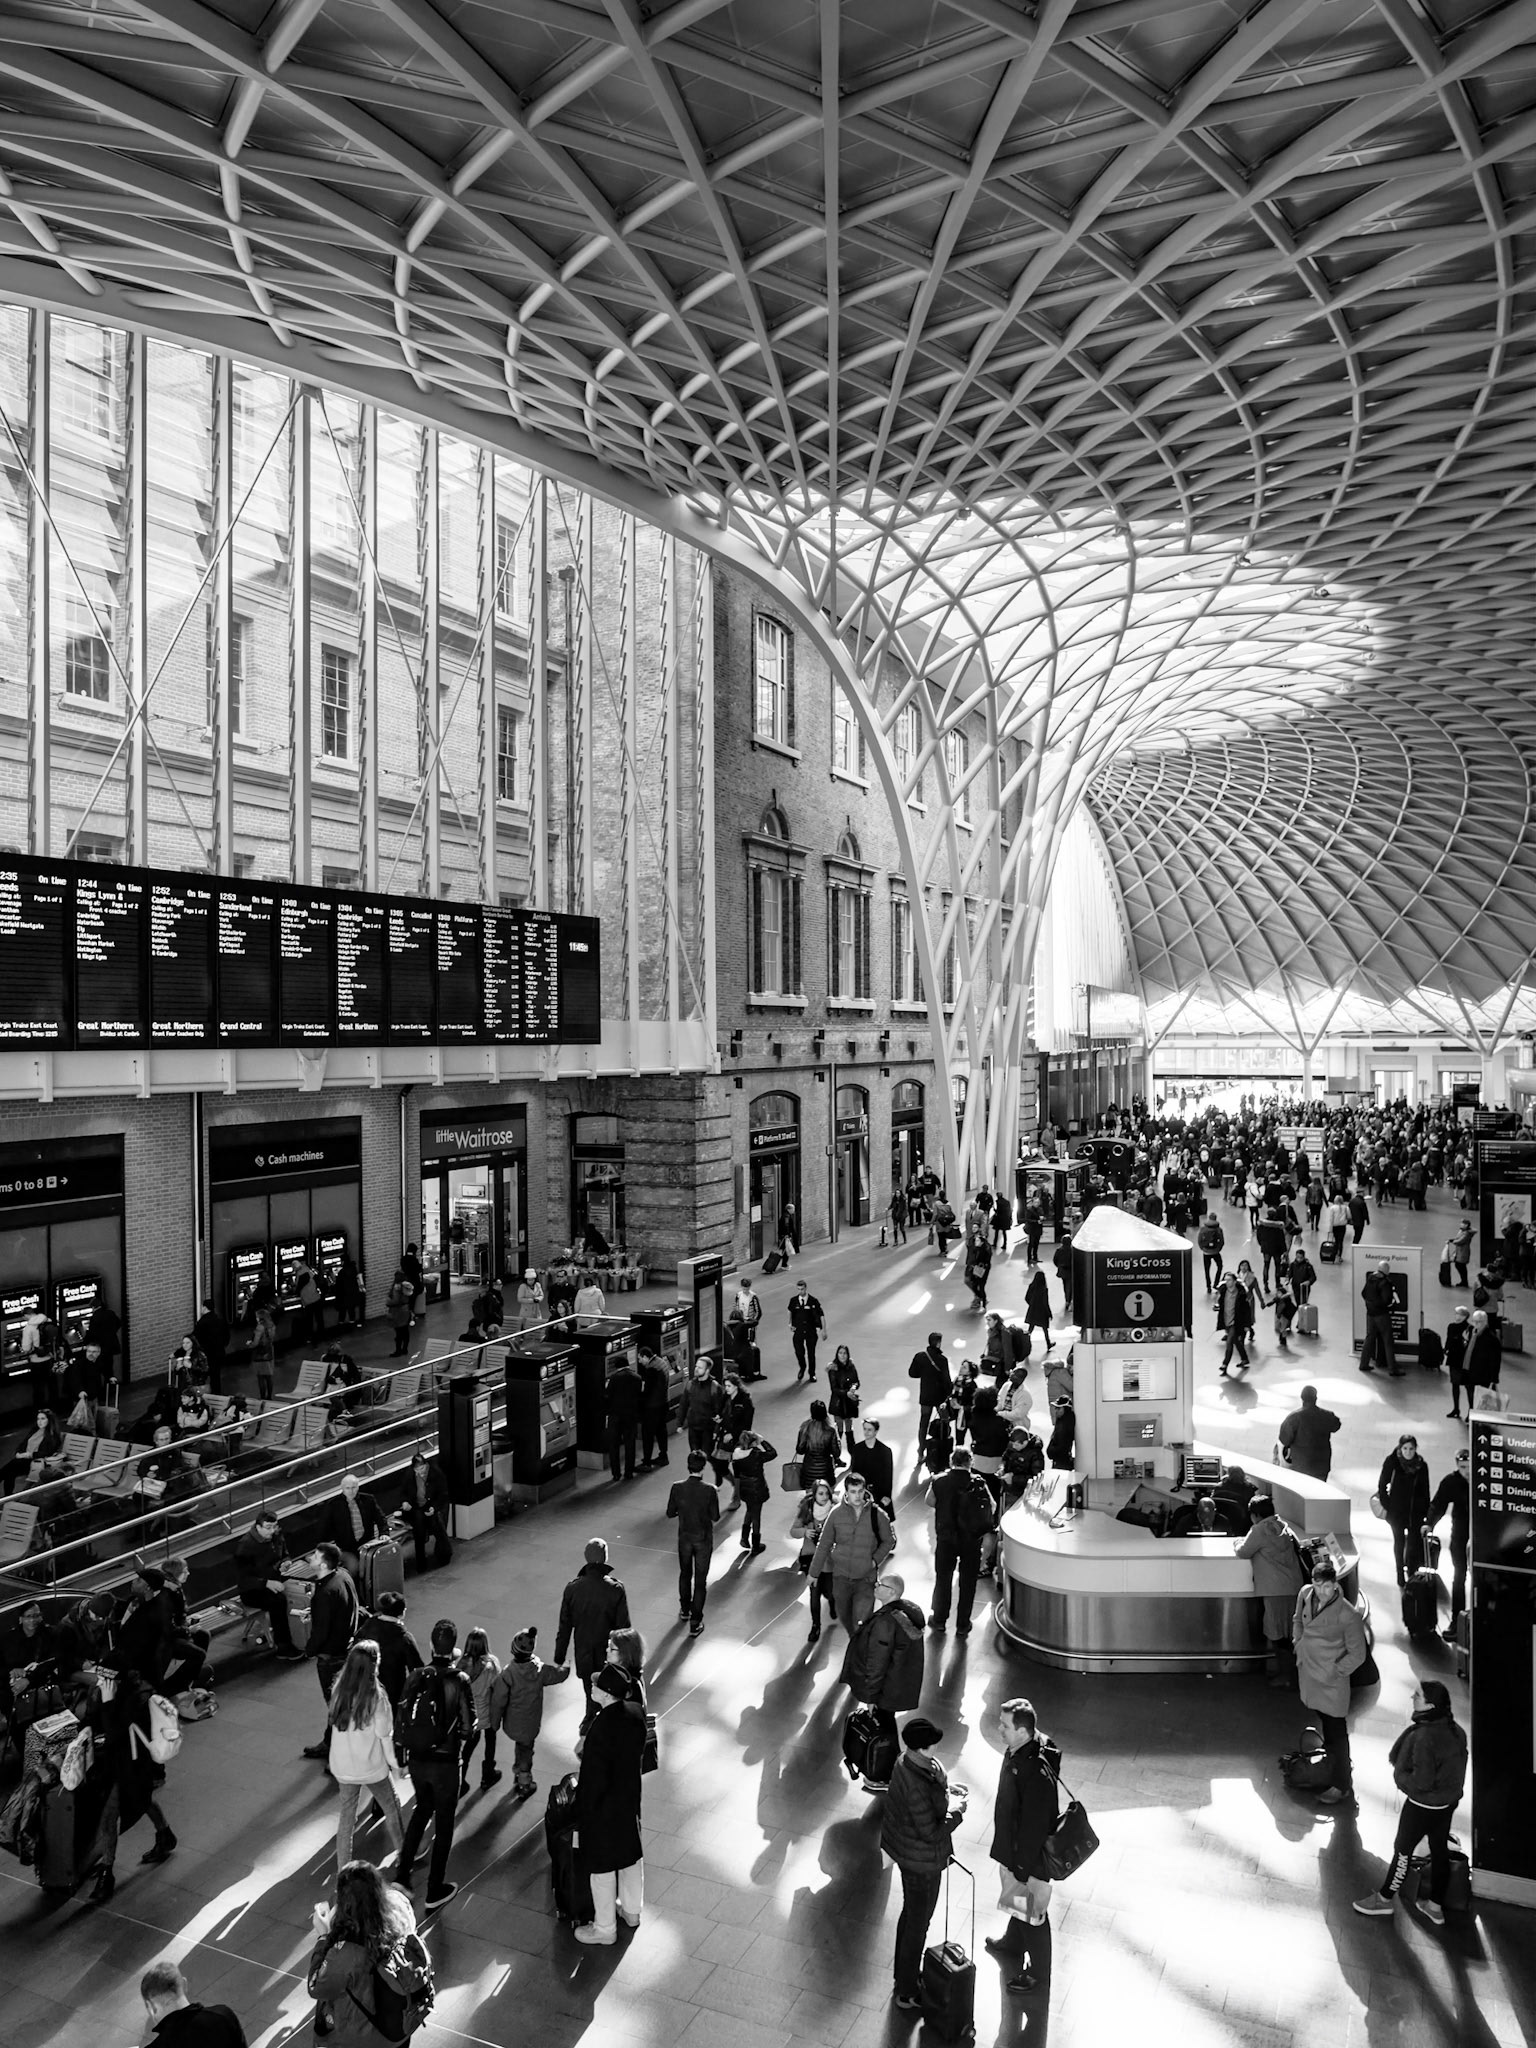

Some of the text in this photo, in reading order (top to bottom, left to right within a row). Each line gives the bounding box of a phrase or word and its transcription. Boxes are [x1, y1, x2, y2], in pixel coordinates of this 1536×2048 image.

[38, 875, 48, 884] On
[51, 876, 66, 885] time
[78, 879, 142, 892] 12:44 On time
[0, 883, 18, 891] eeds
[153, 886, 170, 895] 12:52
[198, 891, 211, 899] time
[77, 889, 96, 899] Kings
[98, 891, 116, 900] Lynn
[152, 896, 184, 906] Cambridge
[220, 893, 236, 901] 12:53
[219, 902, 252, 911] Sunderland
[436, 1127, 513, 1149] little Waitrose
[268, 1151, 324, 1165] Cash machines
[15, 1180, 22, 1191] 0
[24, 1181, 35, 1190] to
[37, 1178, 43, 1188] 8
[1107, 1256, 1171, 1270] King's Cross
[63, 1283, 97, 1297] Free Cash
[2, 1299, 20, 1309] Free
[20, 1294, 39, 1305] Cash
[1506, 1470, 1530, 1480] Taxis
[1507, 1486, 1536, 1500] Dining
[1395, 1852, 1408, 1879] PARK
